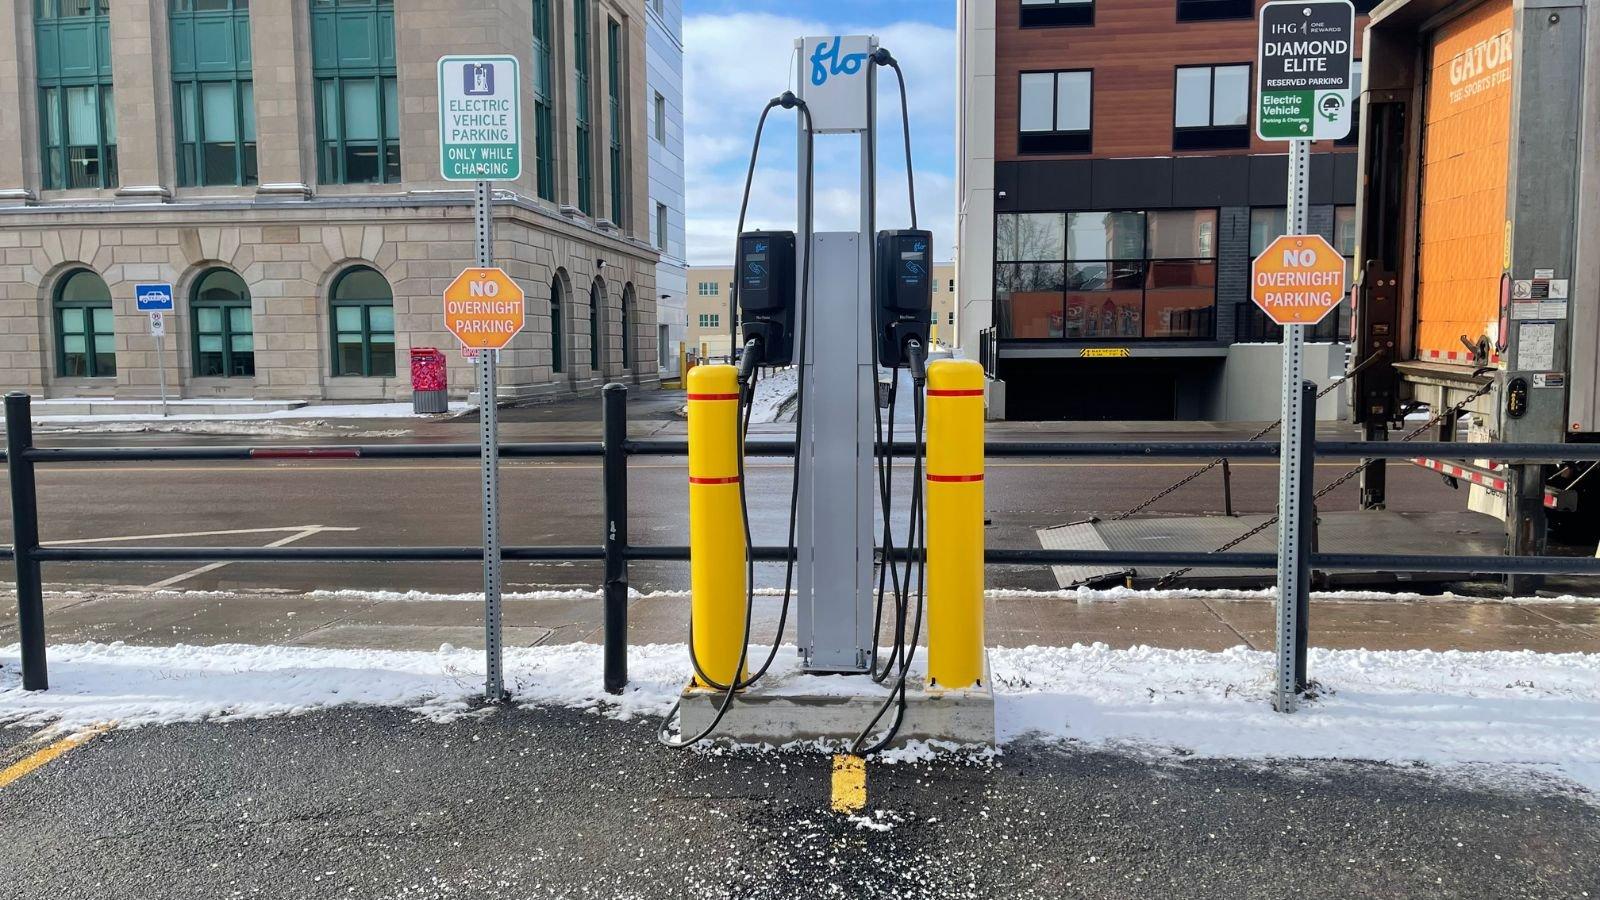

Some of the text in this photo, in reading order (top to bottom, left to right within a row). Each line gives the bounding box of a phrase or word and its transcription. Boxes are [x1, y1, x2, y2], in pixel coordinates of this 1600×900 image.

[1272, 23, 1297, 34] IHG
[1265, 40, 1348, 57] DIAMOND
[810, 36, 868, 86] flo
[1284, 57, 1327, 73] ELITE
[1267, 77, 1344, 87] RESERVED PARKING
[1450, 88, 1464, 104] THE
[1464, 76, 1491, 98] SPORTS
[449, 99, 510, 112] ELECTRIC
[1263, 95, 1302, 105] Electric
[1263, 106, 1300, 116] Vehicle
[453, 114, 507, 126] VEHICLE
[452, 129, 508, 141] PARKING
[448, 148, 513, 160] ONLY WHILE
[1283, 249, 1317, 267] NO
[1257, 271, 1341, 287] OVERNIGHT
[470, 281, 499, 297] NO
[1264, 292, 1332, 307] PARKING
[448, 301, 520, 314] OVERNIGHT
[455, 320, 514, 333] PARKING
